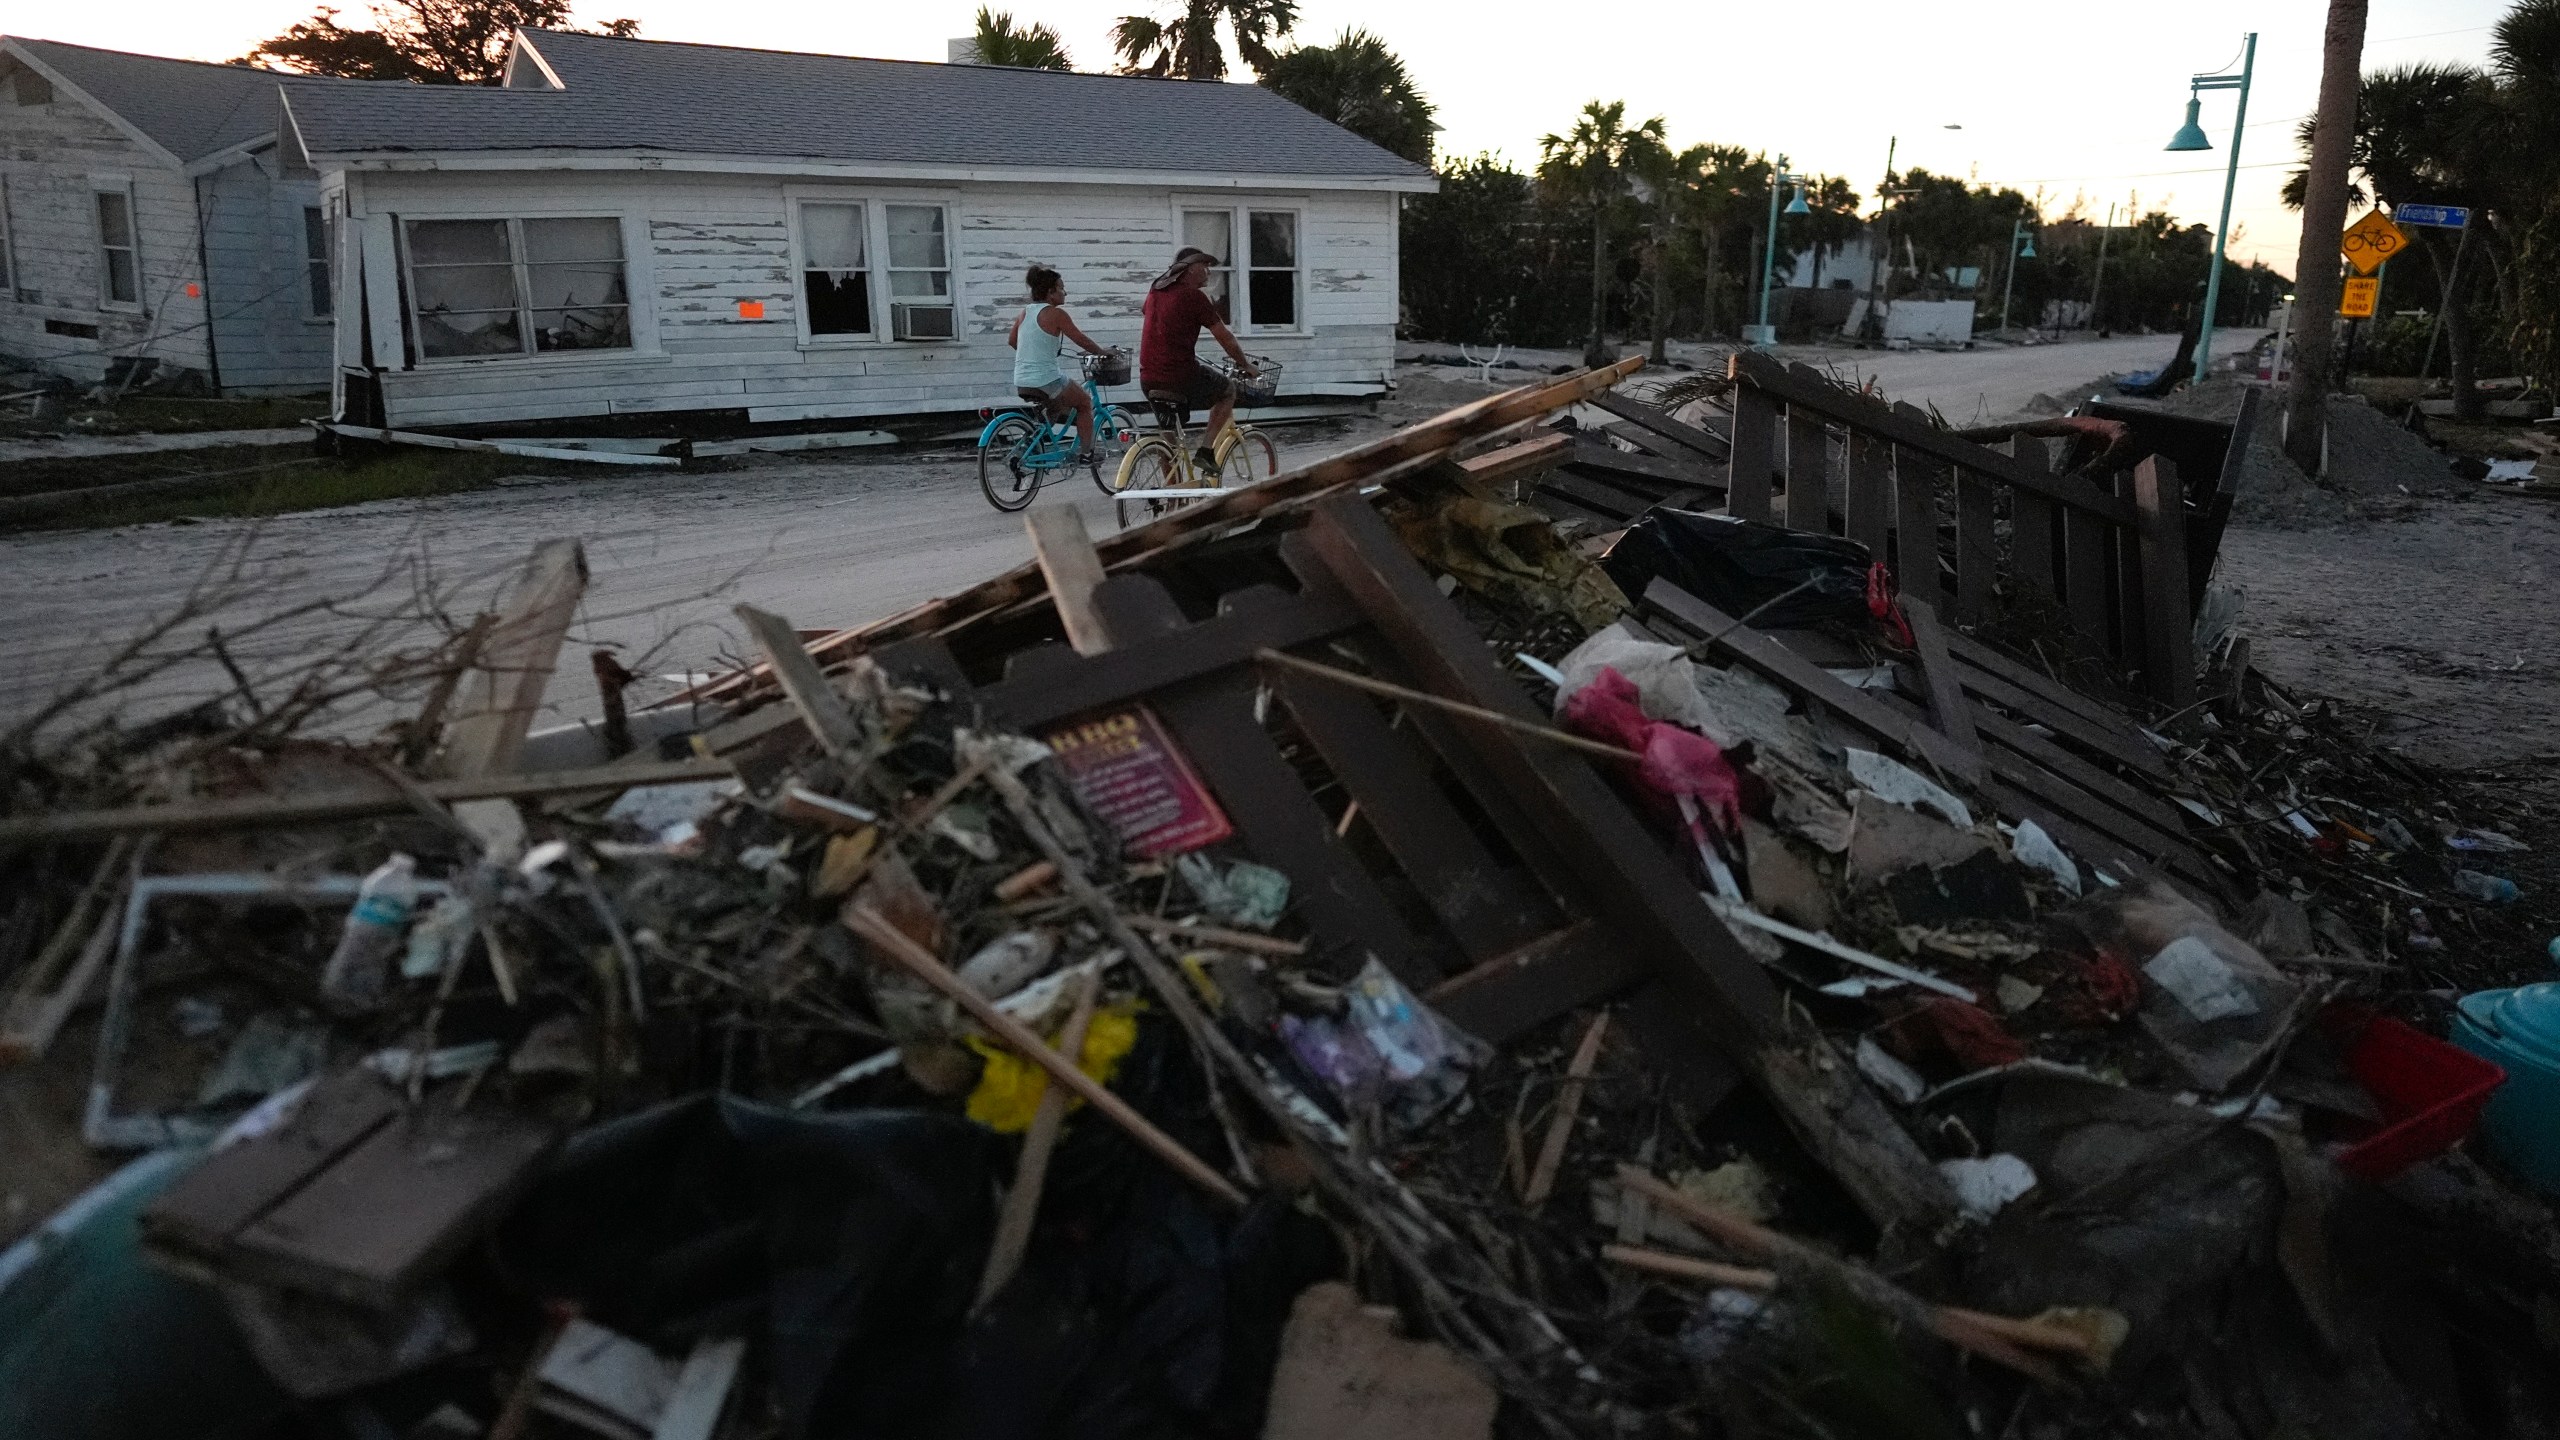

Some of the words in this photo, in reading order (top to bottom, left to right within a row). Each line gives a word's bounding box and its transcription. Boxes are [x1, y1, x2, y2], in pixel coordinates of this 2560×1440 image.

[2400, 205, 2447, 222] Friendship
[2349, 281, 2374, 290] SHARE
[2352, 292, 2366, 301] THE
[2346, 303, 2369, 311] ROAD
